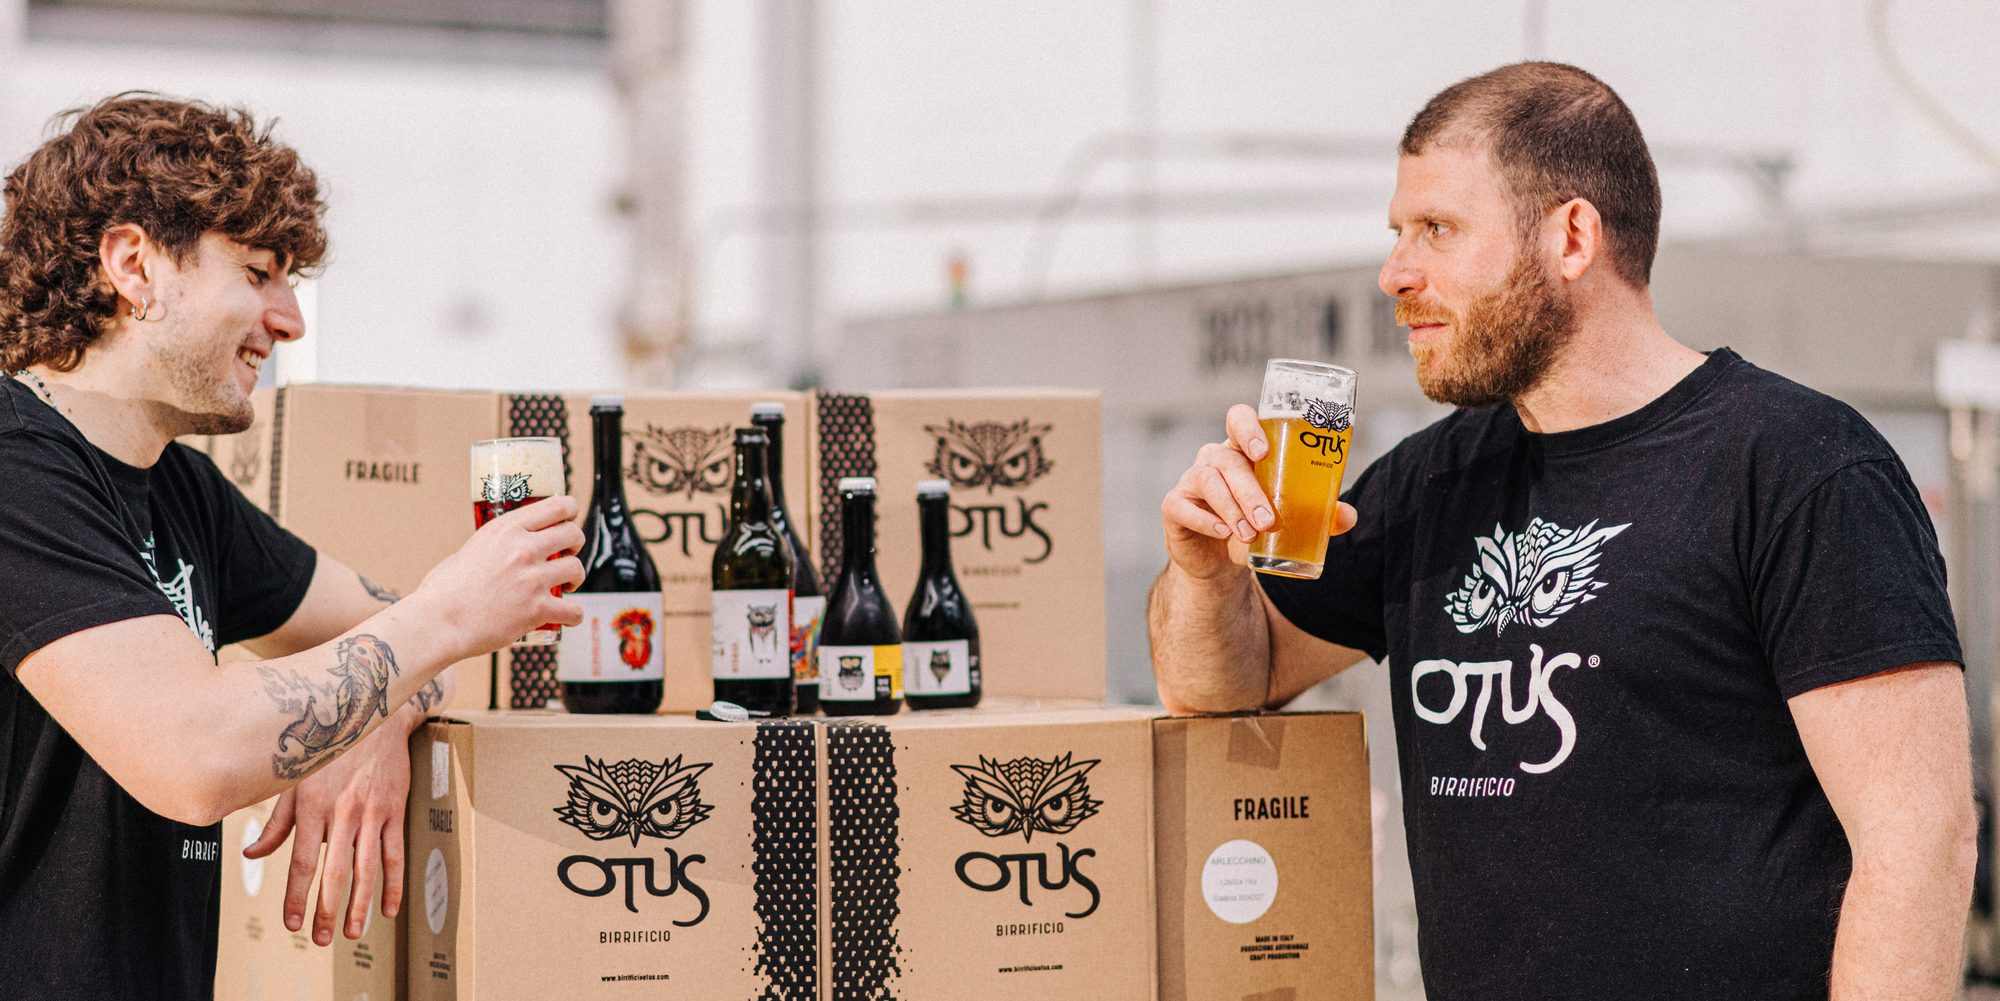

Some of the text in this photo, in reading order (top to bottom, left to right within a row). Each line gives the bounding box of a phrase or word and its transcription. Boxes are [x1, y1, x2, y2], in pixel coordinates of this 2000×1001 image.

[1299, 431, 1346, 465] OTUS
[345, 460, 420, 482] FRAGILE
[631, 503, 729, 557] OTU
[1411, 643, 1582, 774] OTUS
[1430, 776, 1515, 797] BIRRIFICIO
[429, 807, 453, 833] FRAGILE
[1233, 796, 1310, 821] FRAGILE
[182, 839, 218, 861] BIRRIF
[1211, 855, 1267, 866] ARLECCHINO
[557, 847, 710, 927] OTUS
[955, 842, 1101, 919] OTUS
[599, 930, 671, 944] BIRRIFICIO
[996, 922, 1064, 937] BIRRIFICIO
